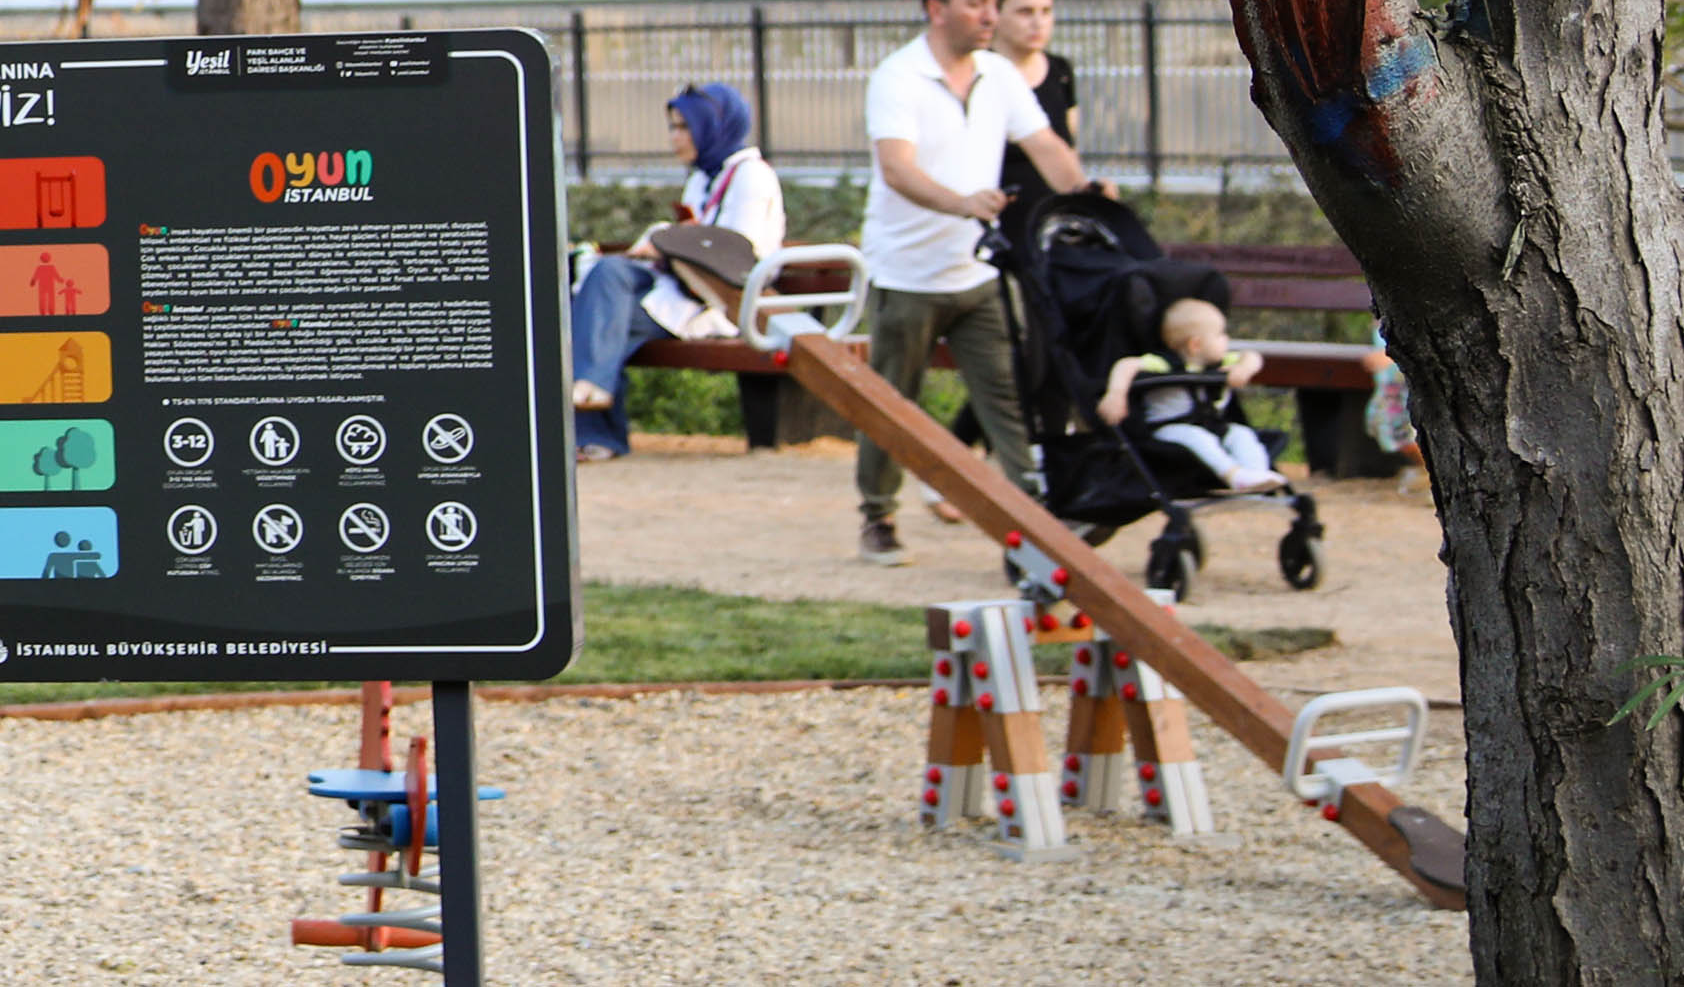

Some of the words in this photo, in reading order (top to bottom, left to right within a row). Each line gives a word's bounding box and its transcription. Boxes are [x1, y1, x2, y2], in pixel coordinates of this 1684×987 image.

[186, 50, 231, 75] Yeşil
[249, 149, 373, 203] Oyun
[172, 435, 206, 449] 3-12
[16, 640, 99, 656] İSTANBUL
[106, 639, 219, 657] BÜYÜKŞEHİR
[226, 639, 328, 655] BELEDİYESİ
